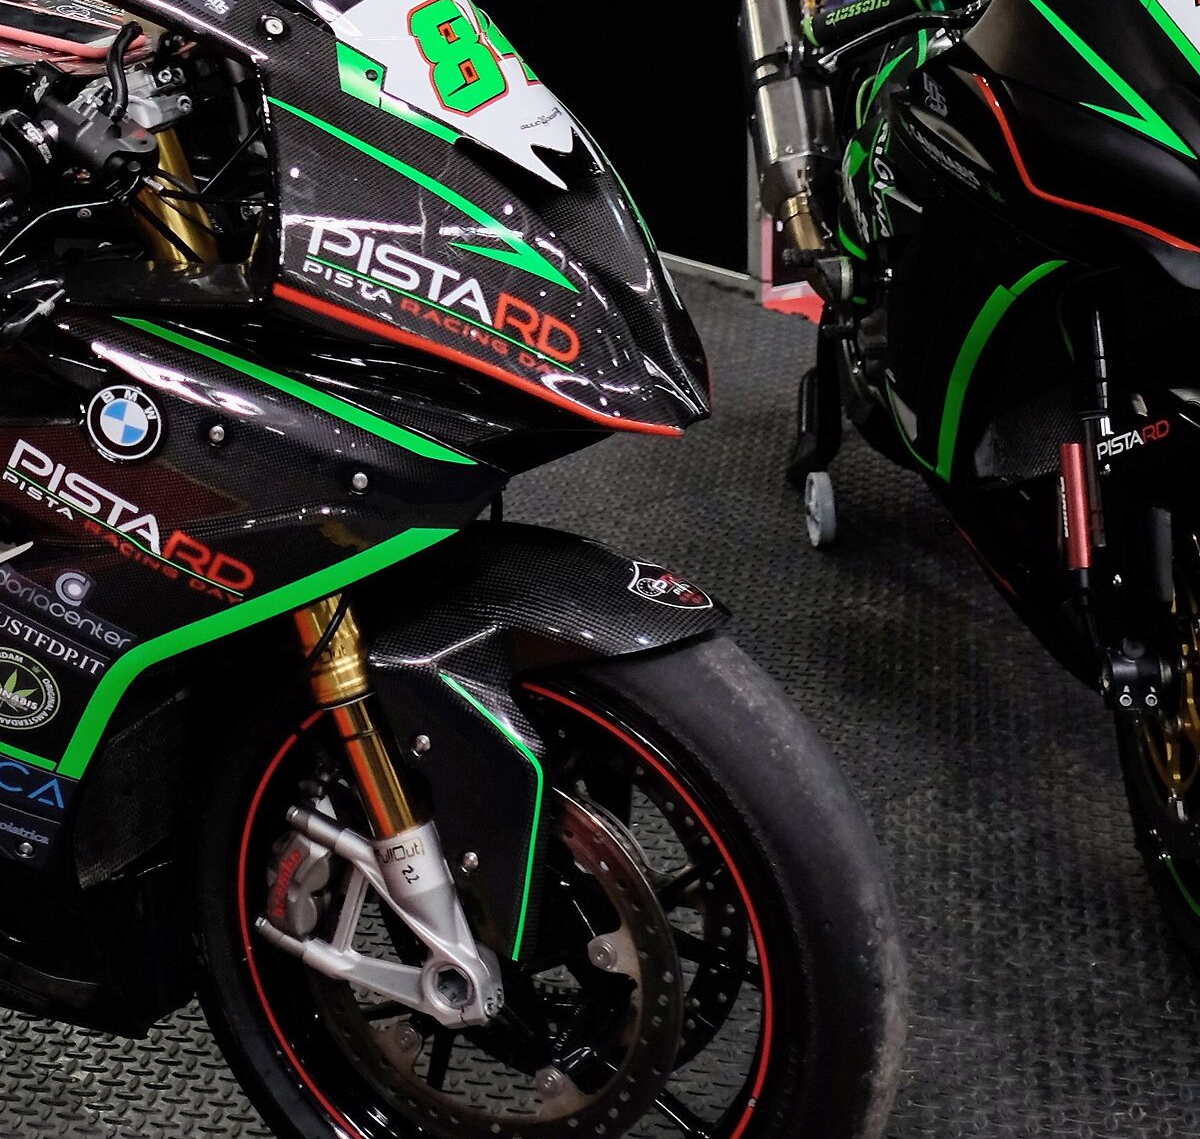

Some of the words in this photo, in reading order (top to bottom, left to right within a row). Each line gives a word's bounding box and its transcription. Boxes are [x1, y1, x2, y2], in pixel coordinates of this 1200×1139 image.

[302, 261, 392, 305] PISTA
[400, 298, 510, 355] RACING
[306, 219, 582, 364] PISTARD
[100, 389, 157, 420] BMW
[1096, 419, 1170, 461] PISTARD
[2, 471, 75, 521] PISTA
[84, 519, 179, 581] RACING
[7, 438, 255, 592] PISTARD
[42, 677, 57, 712] ORIGINAL
